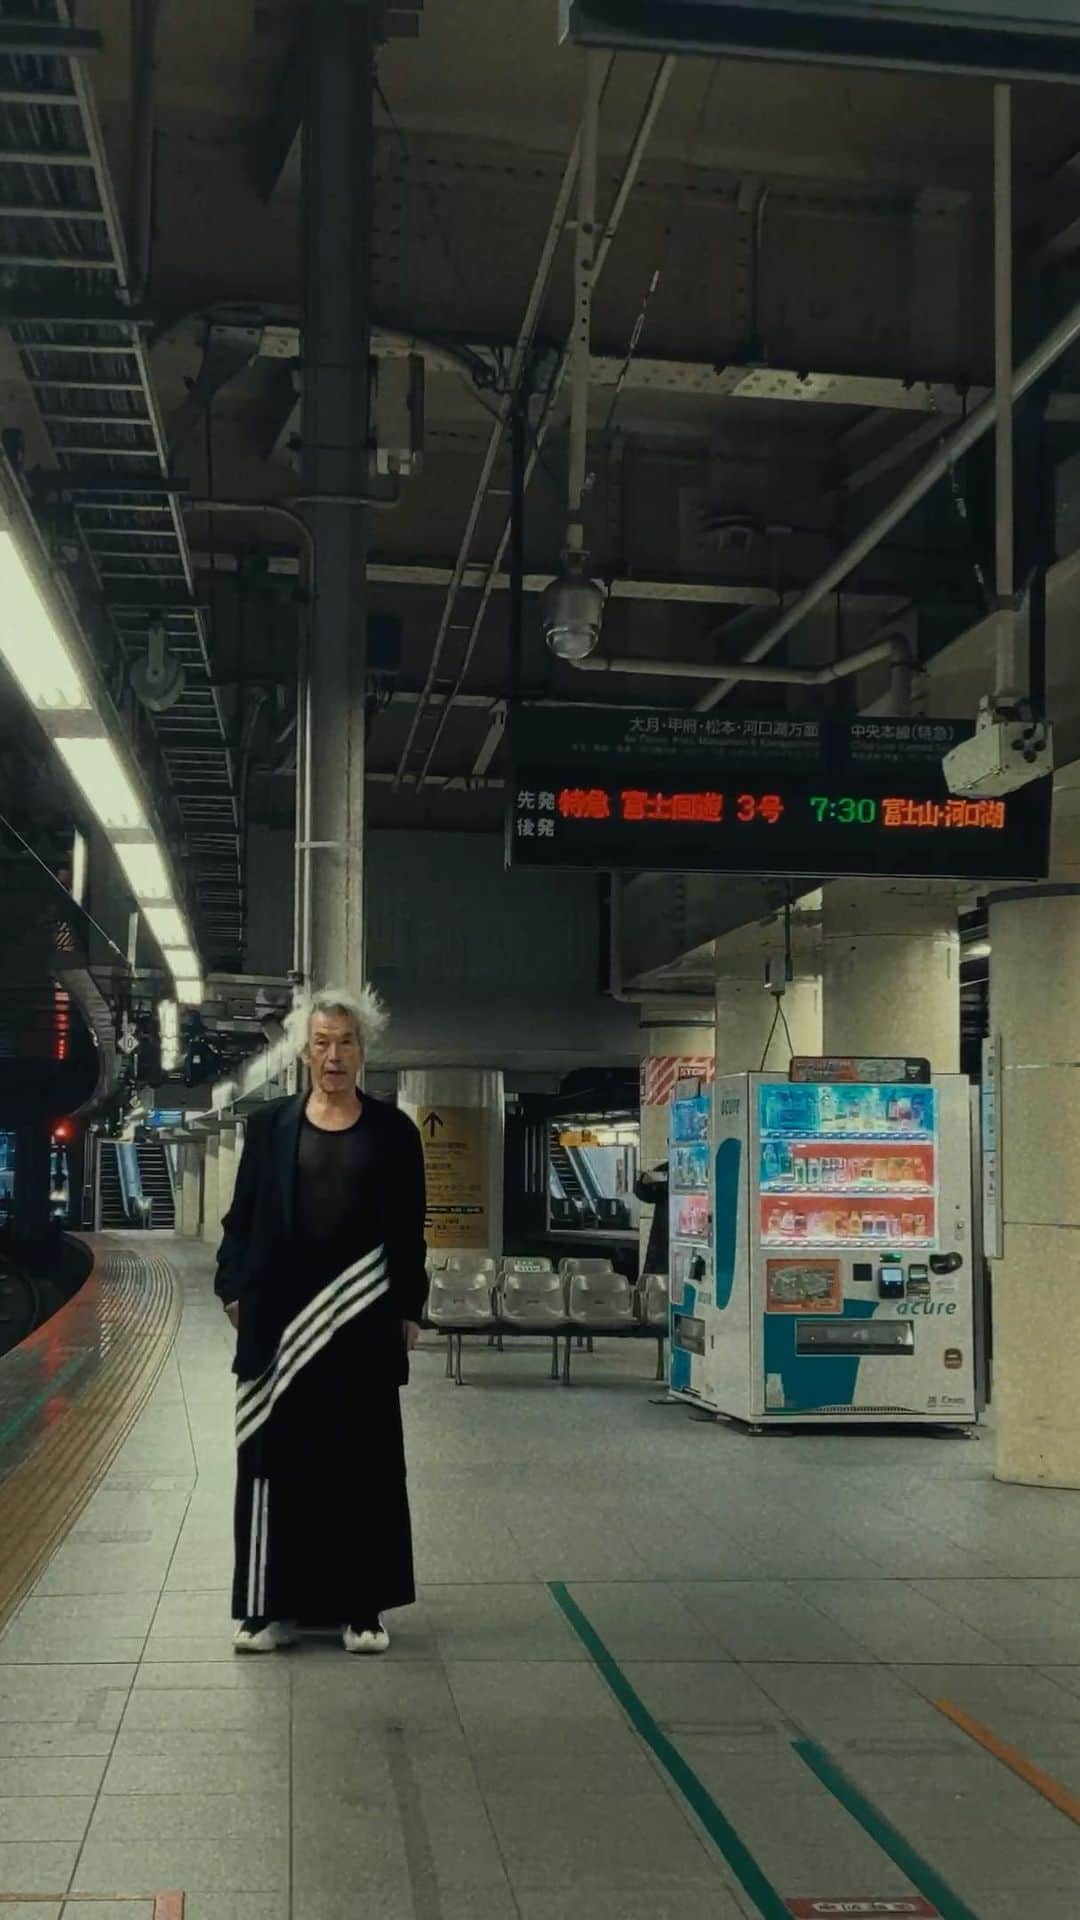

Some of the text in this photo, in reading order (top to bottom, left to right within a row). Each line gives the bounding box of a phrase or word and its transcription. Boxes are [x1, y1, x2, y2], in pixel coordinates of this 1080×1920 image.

[517, 789, 556, 811] 先発
[736, 793, 784, 823] 3号
[808, 796, 876, 823] 7:30
[517, 818, 556, 838] 後発
[896, 1301, 957, 1316] acure
